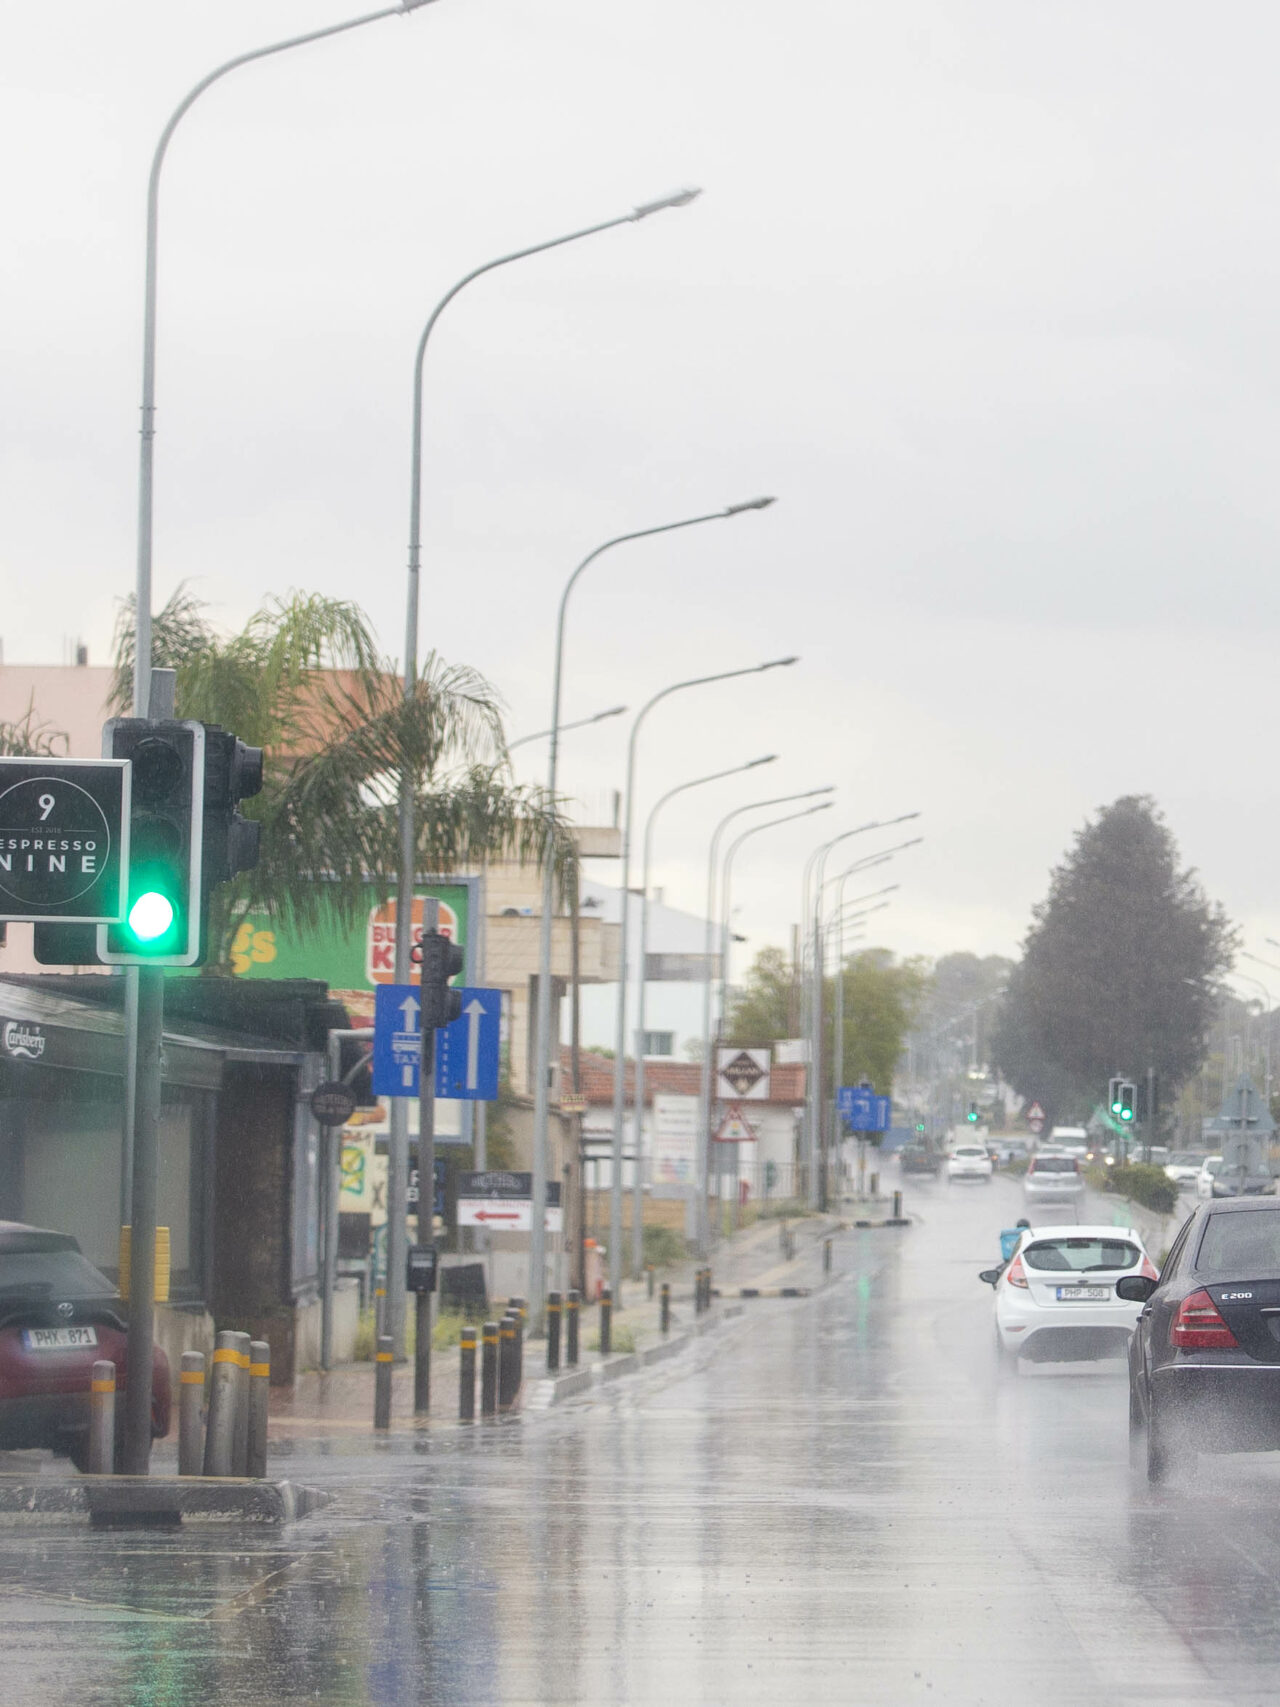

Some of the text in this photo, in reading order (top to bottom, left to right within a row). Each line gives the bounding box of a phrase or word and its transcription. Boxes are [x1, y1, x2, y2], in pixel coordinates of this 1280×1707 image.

[39, 794, 55, 820] 9
[0, 854, 96, 873] NINE
[5, 1021, 46, 1058] Carlsberg
[393, 1053, 421, 1064] TAX
[1229, 1292, 1253, 1300] 200
[35, 1328, 92, 1346] PHX 871
